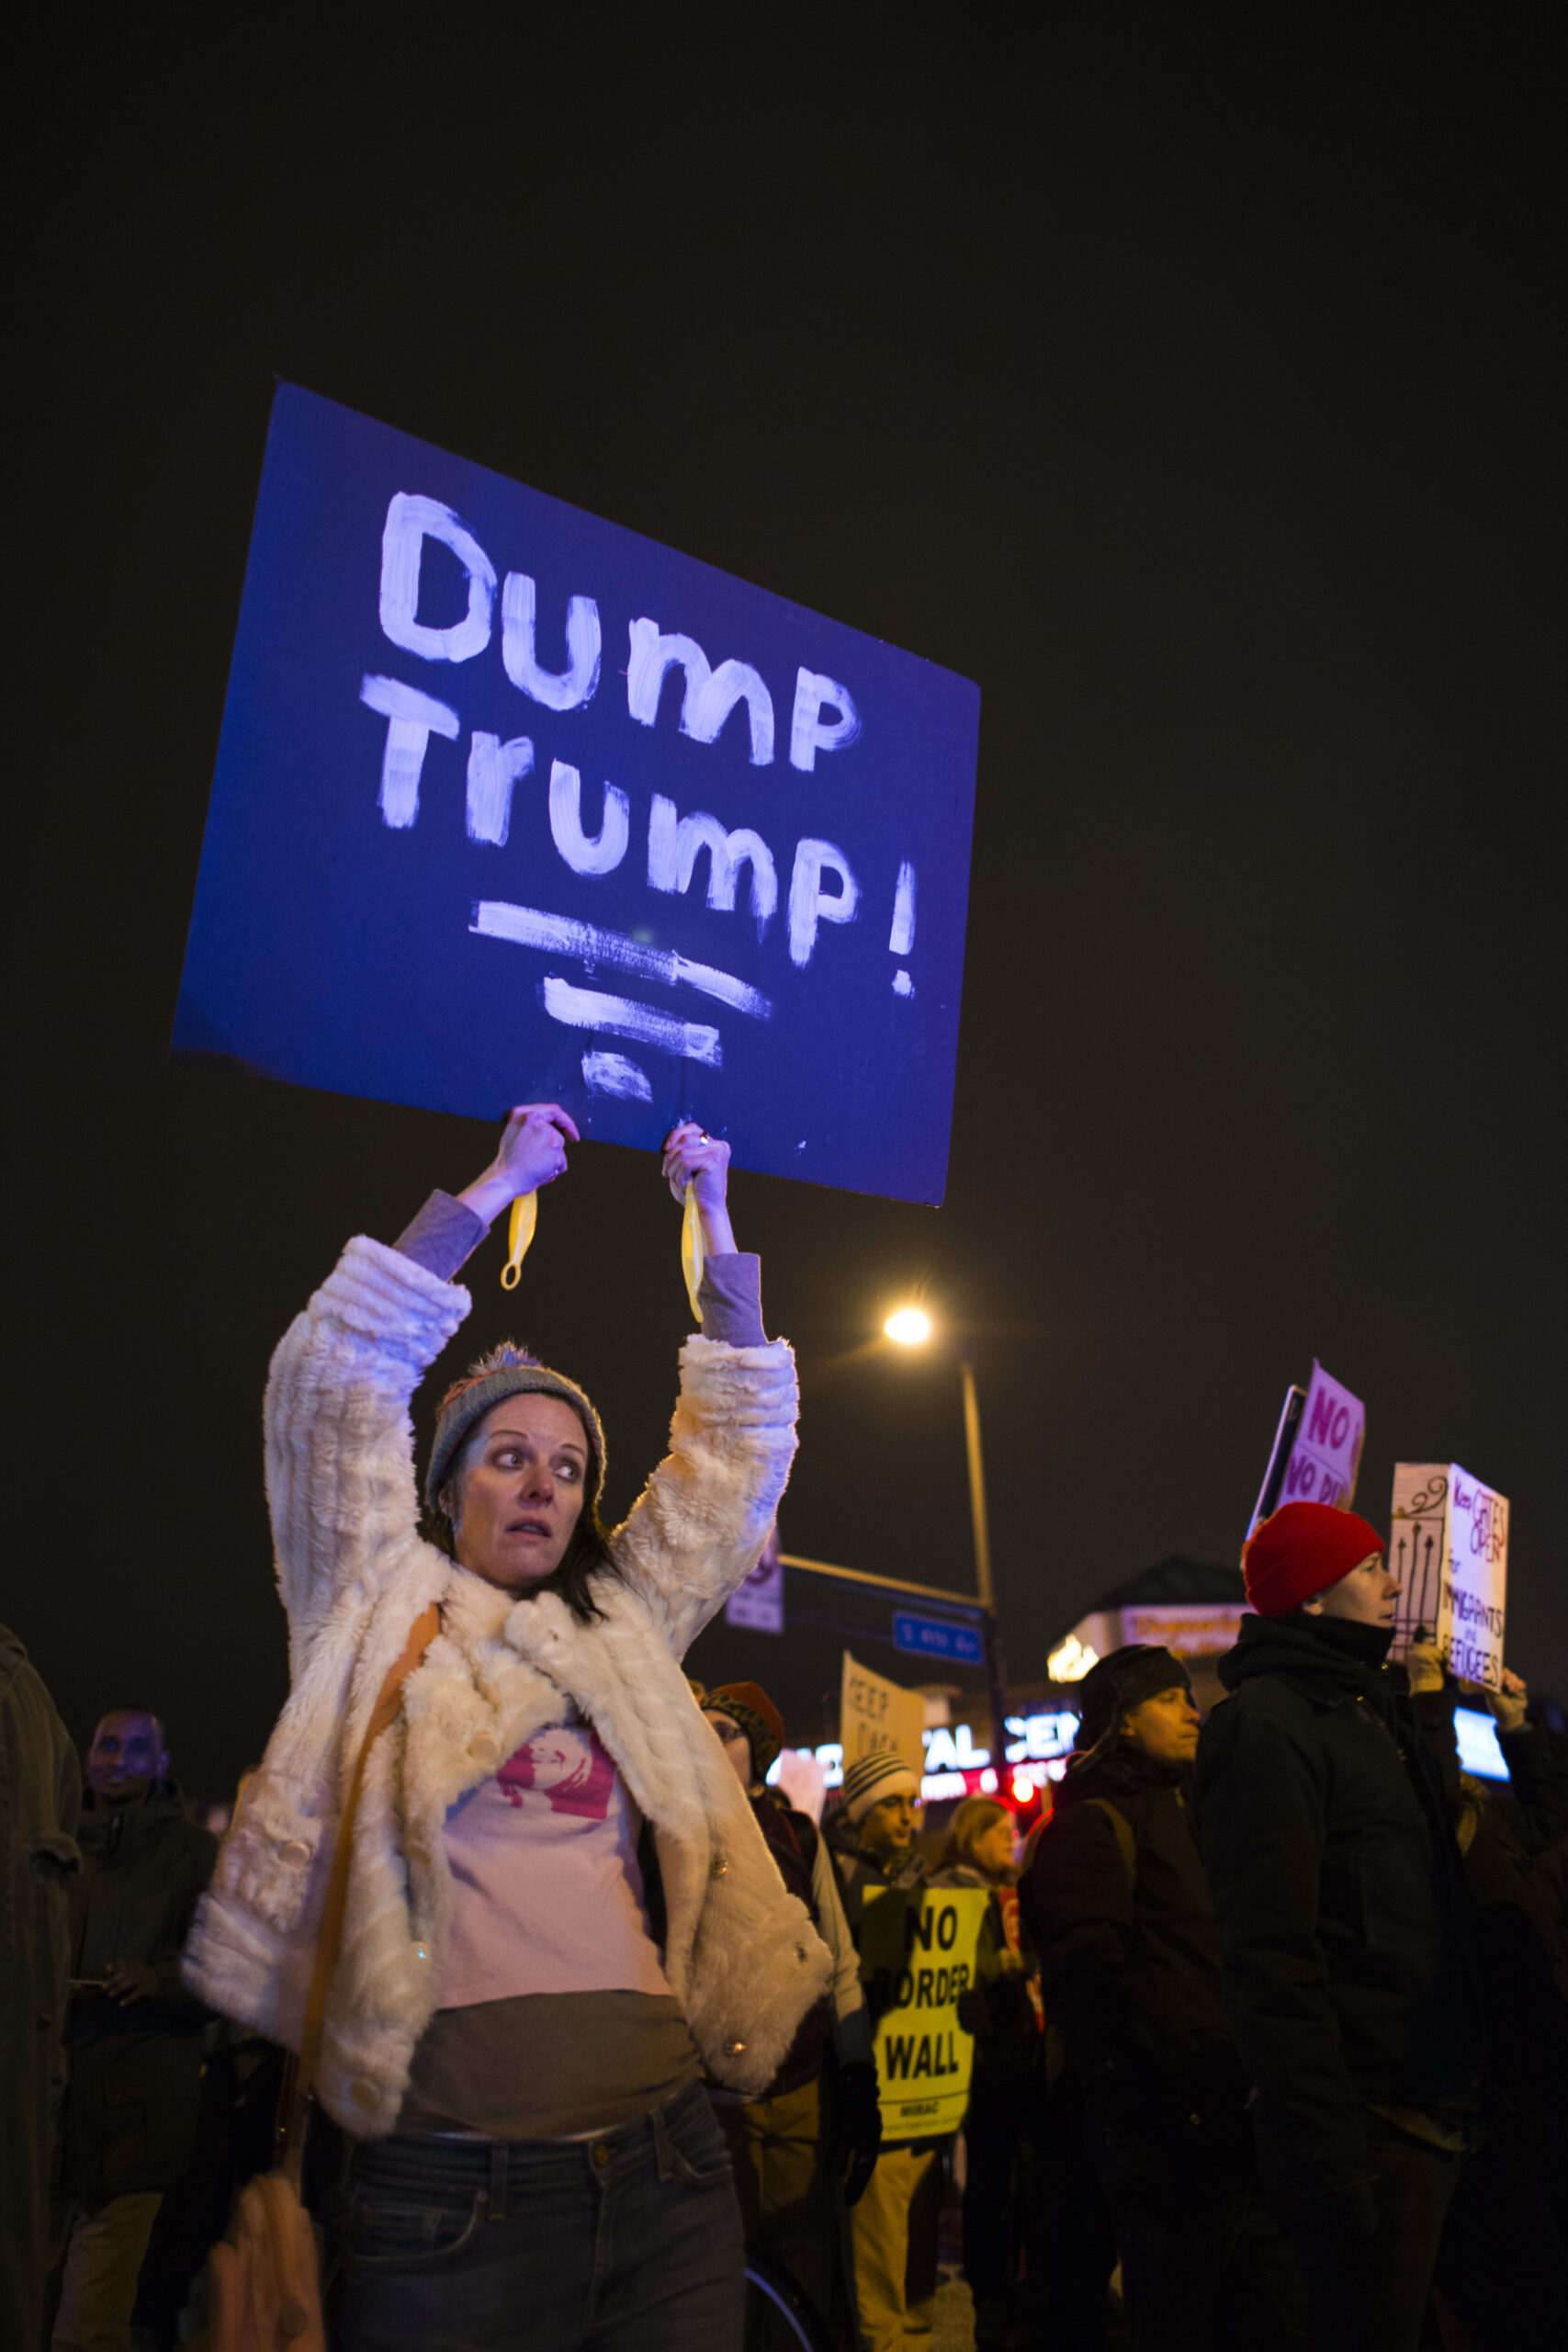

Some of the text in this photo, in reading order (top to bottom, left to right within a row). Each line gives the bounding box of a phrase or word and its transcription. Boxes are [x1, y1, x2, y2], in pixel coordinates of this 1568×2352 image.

[1307, 1386, 1350, 1449] NO
[905, 1905, 957, 1951] NO
[885, 2030, 959, 2081] WALL
